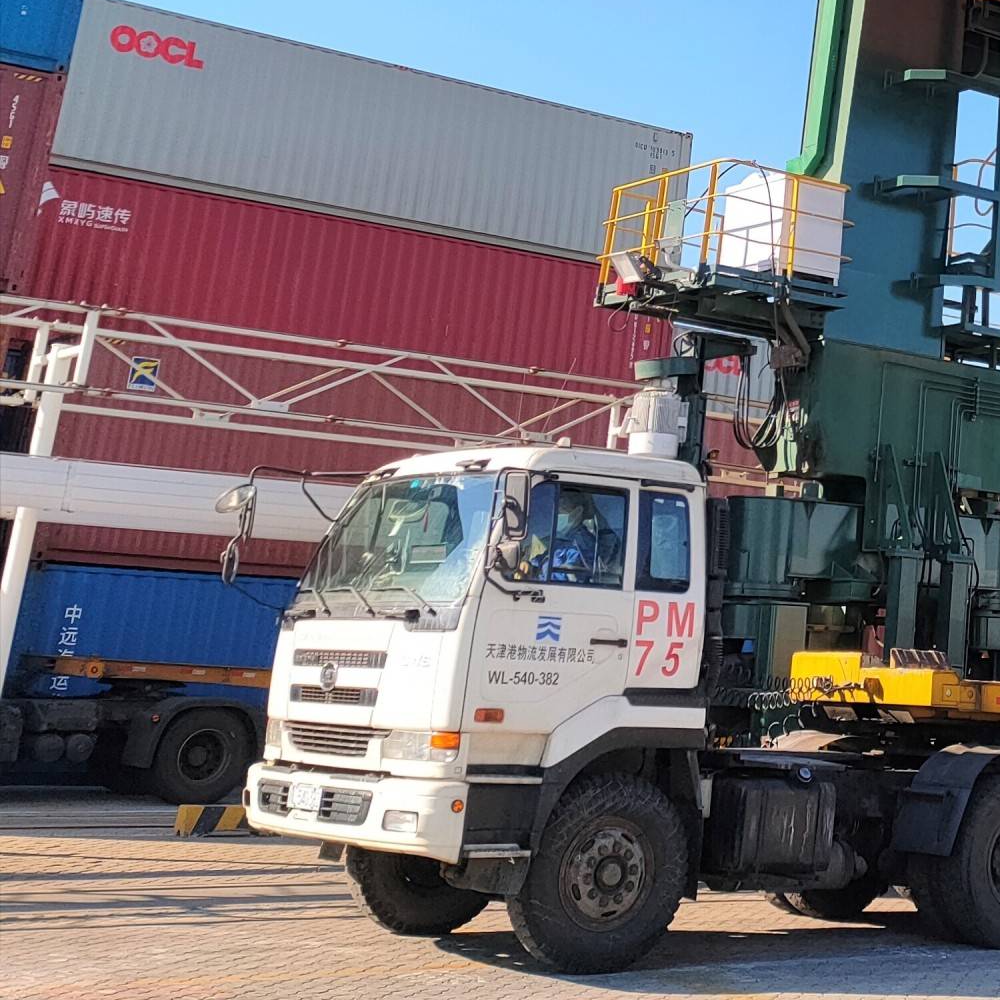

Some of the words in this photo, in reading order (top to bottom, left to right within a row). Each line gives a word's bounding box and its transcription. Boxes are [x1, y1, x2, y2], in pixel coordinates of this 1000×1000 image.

[110, 25, 204, 70] OOCL
[8, 94, 20, 129] 45G1
[636, 599, 696, 638] PM
[485, 643, 596, 665] 天津港物流发展有限公司
[635, 640, 685, 678] 75
[487, 670, 560, 687] WL-540-382
